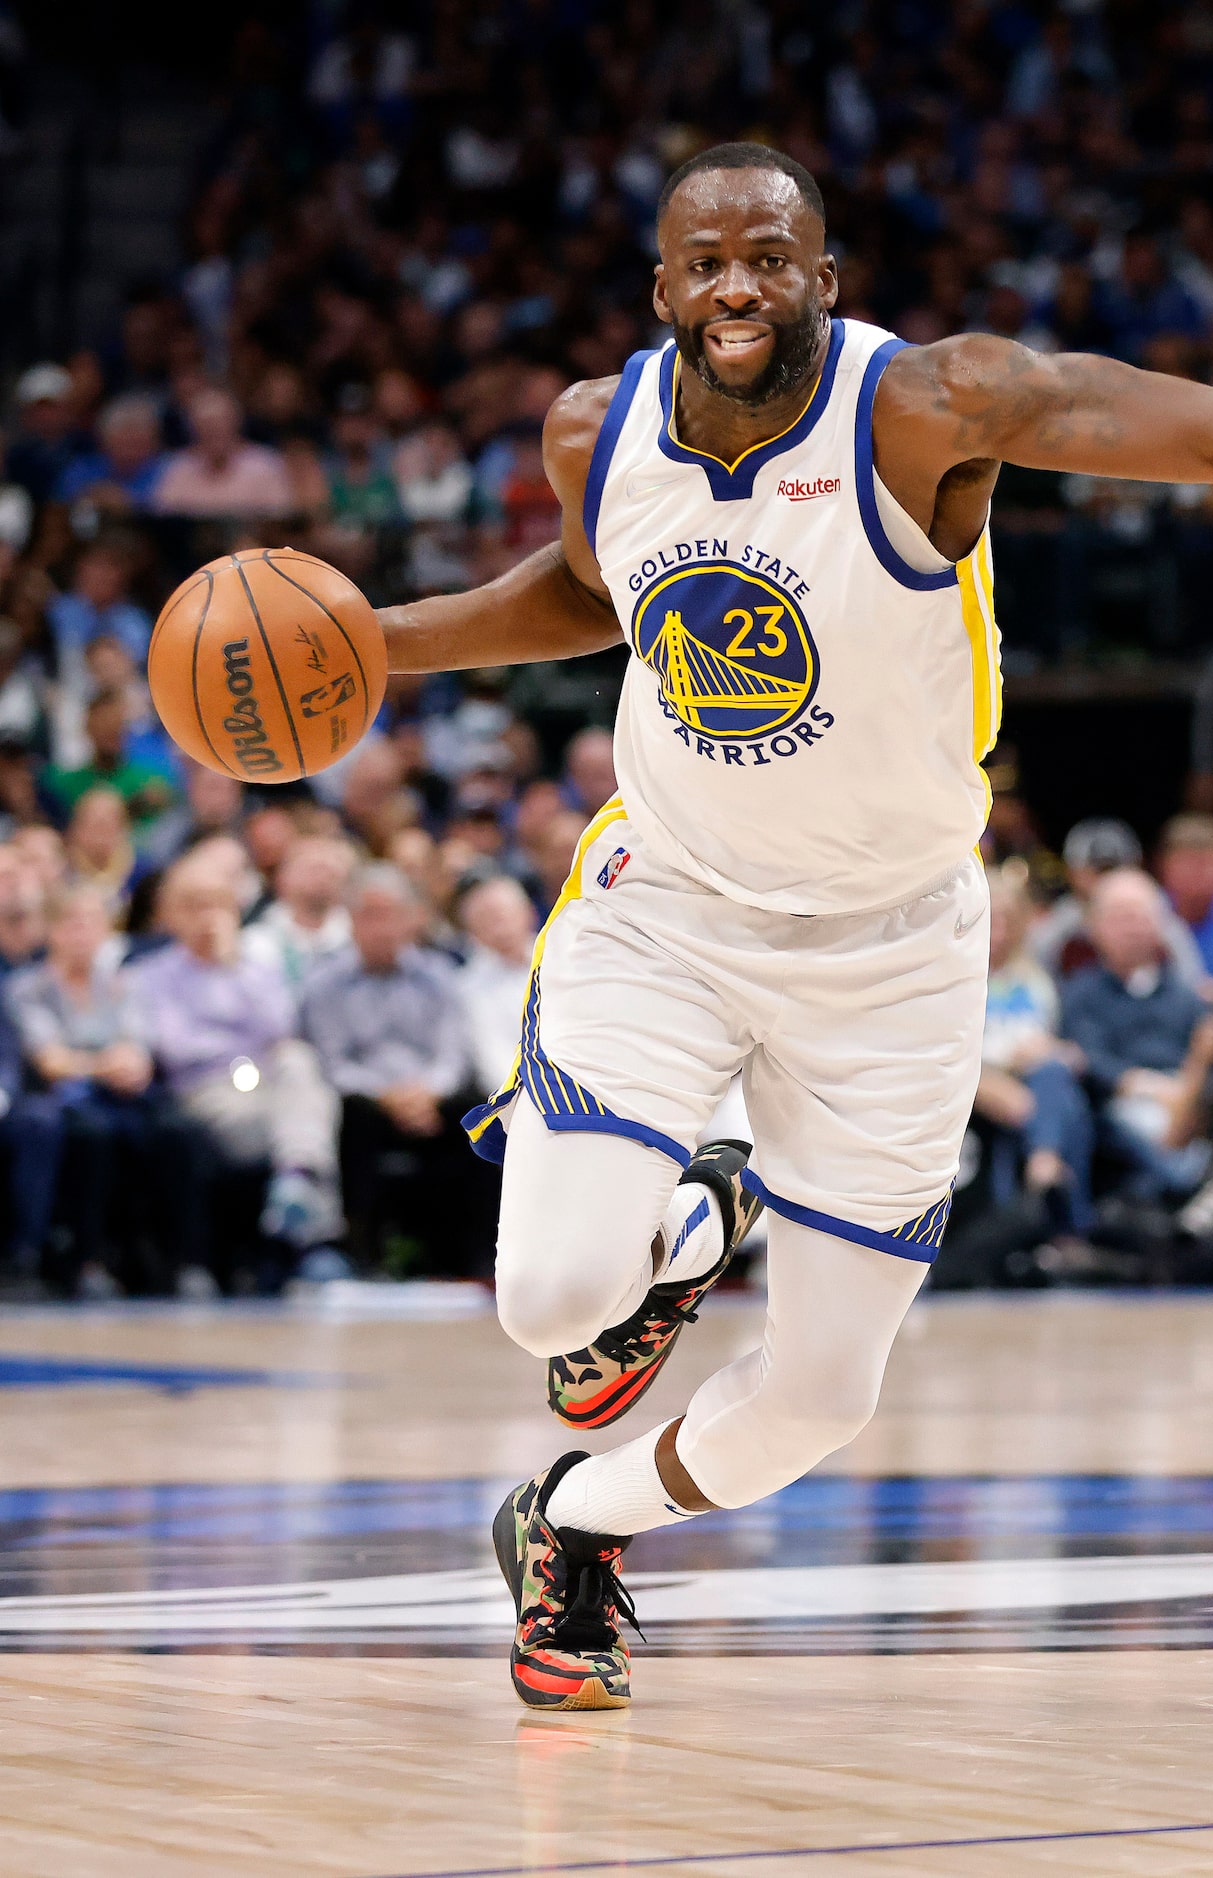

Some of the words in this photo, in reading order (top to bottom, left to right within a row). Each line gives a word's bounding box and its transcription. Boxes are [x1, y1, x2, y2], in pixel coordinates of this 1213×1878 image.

[777, 477, 841, 496] Rakuten
[628, 538, 728, 593] GOLDEN
[741, 544, 811, 601] STATE
[722, 605, 788, 657] 23
[221, 636, 284, 777] Wilson
